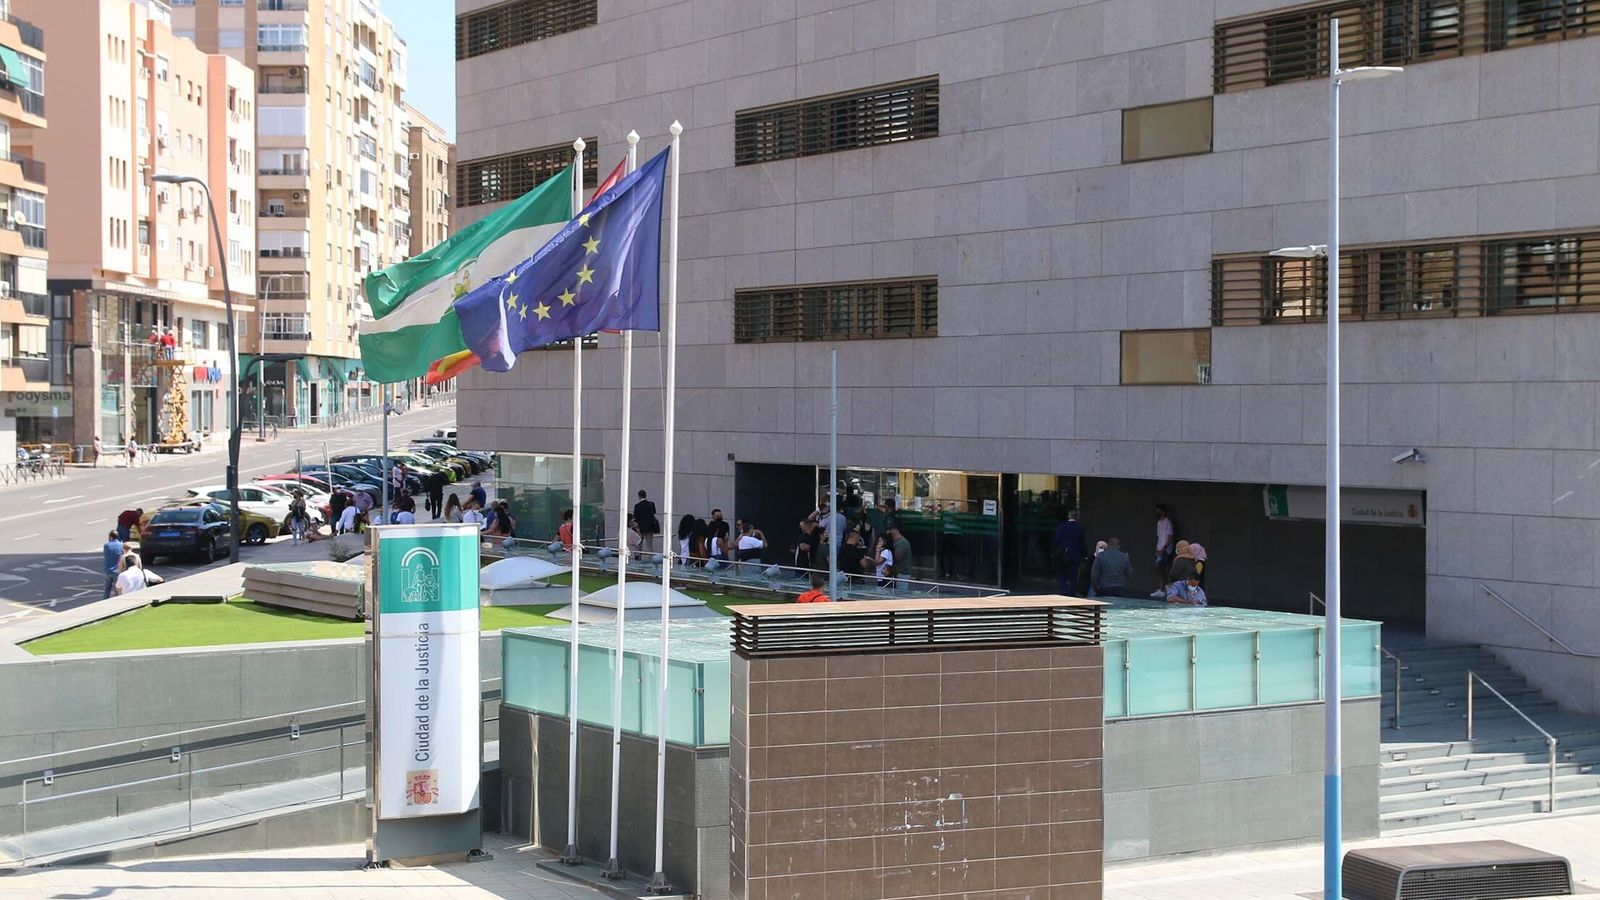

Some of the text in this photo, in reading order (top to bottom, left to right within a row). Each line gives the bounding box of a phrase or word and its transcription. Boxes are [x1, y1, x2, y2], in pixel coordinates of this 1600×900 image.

[414, 622, 430, 762] Ciudad de la Justicia
